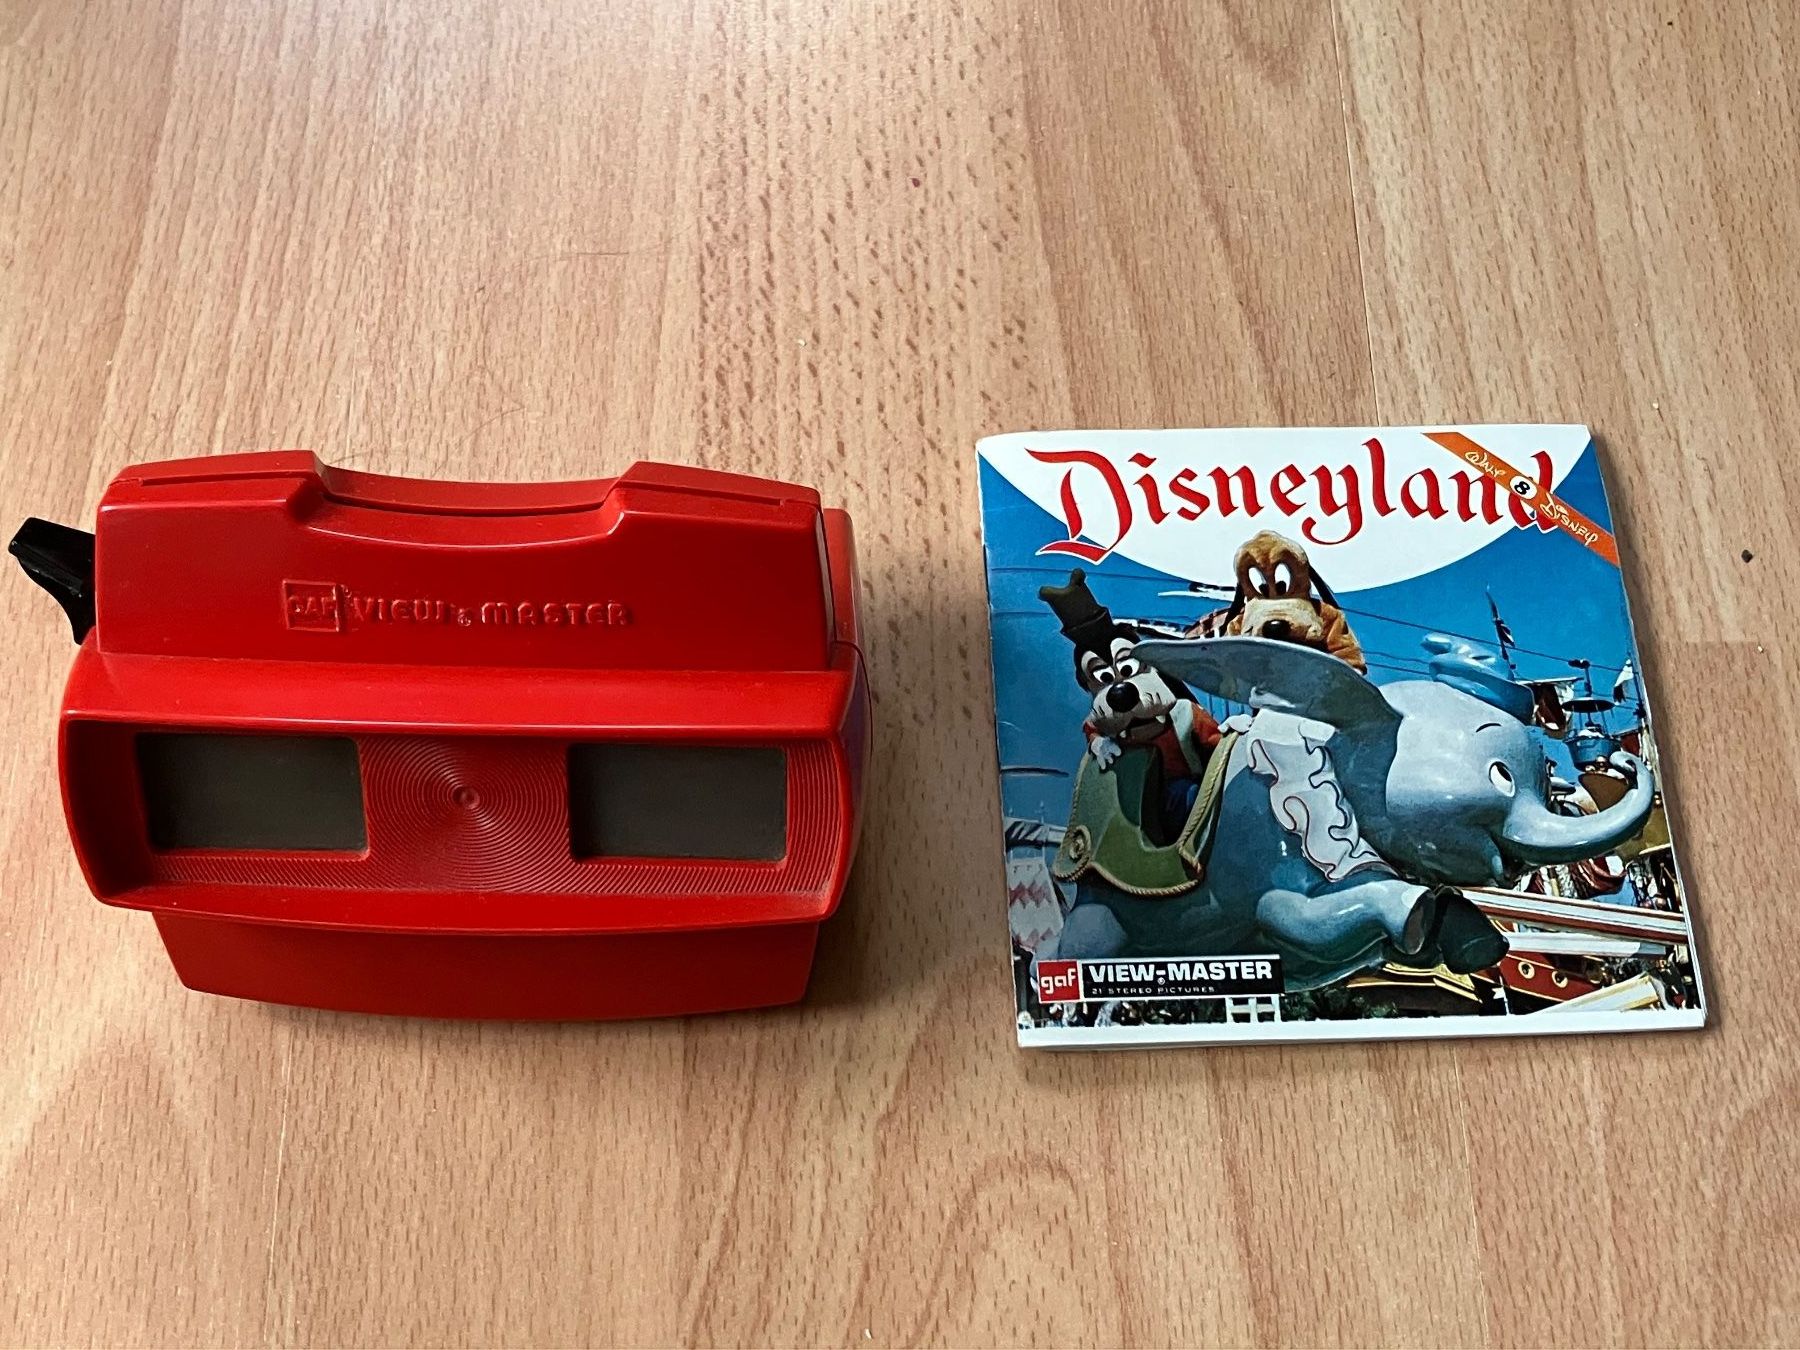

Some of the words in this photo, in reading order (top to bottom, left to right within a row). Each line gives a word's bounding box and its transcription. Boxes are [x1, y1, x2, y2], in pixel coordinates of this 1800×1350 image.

[1025, 438, 1554, 564] Disneyland
[1040, 968, 1077, 994] gaf
[1089, 961, 1272, 983] VIEW-MASTER
[1108, 987, 1152, 995] STEREO
[1157, 986, 1215, 995] PICTURES
